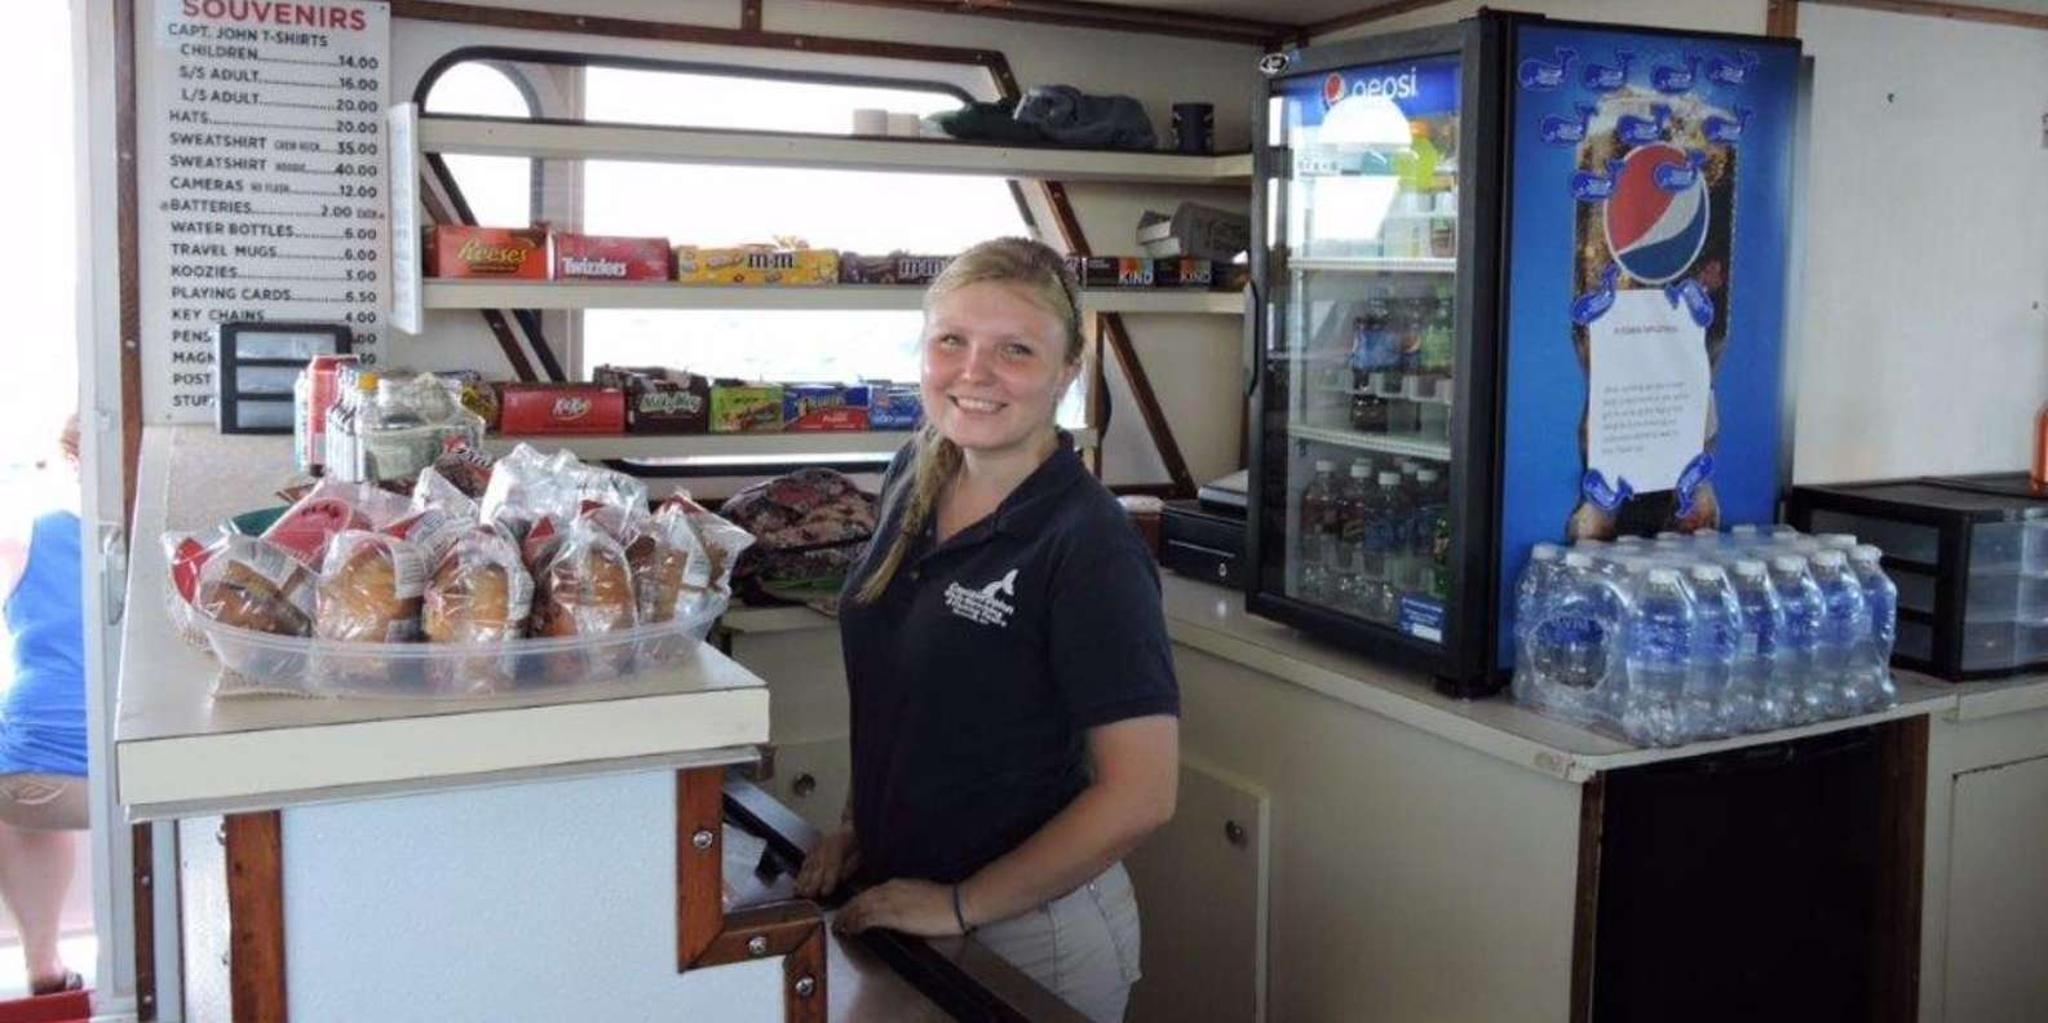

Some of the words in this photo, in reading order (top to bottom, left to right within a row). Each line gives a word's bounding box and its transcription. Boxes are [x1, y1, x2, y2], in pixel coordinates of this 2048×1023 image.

[183, 0, 367, 31] SOUVENIRS
[168, 23, 211, 39] CAPT.
[216, 27, 258, 42] JOHN
[263, 31, 328, 47] T-SHIRTS
[181, 43, 258, 60] CHILDREN
[338, 54, 379, 69] 14.00
[179, 66, 206, 80] S/S
[210, 68, 259, 82] ADULT
[339, 77, 379, 91] 16.00
[181, 88, 207, 101] L/S
[211, 90, 259, 104] ADULT
[336, 98, 378, 113] 20.00
[169, 110, 209, 124] HATS
[336, 120, 378, 134] 20.00
[169, 132, 267, 149] SWEATSHIRT
[169, 154, 268, 171] SWEATSHIRT
[335, 163, 377, 177] 40.00
[170, 176, 243, 192] CAMERAS
[340, 184, 377, 198] 12.00
[170, 198, 251, 214] BATTERIES
[321, 204, 353, 218] 2.00
[171, 221, 225, 235] WATER
[229, 223, 295, 238] BOTTLES
[171, 243, 228, 257] TRAVEL
[235, 245, 278, 258] MUGS
[171, 264, 238, 279] KOOZIES
[562, 256, 627, 277] Twizzlers
[1118, 270, 1155, 285] KIND
[1179, 269, 1213, 284] KIND
[171, 286, 236, 300] PLAYING
[241, 288, 292, 302] CARDS
[172, 307, 202, 321] KEY
[208, 309, 265, 323] CHAINS
[172, 330, 212, 343] PENS
[173, 373, 211, 386] POST
